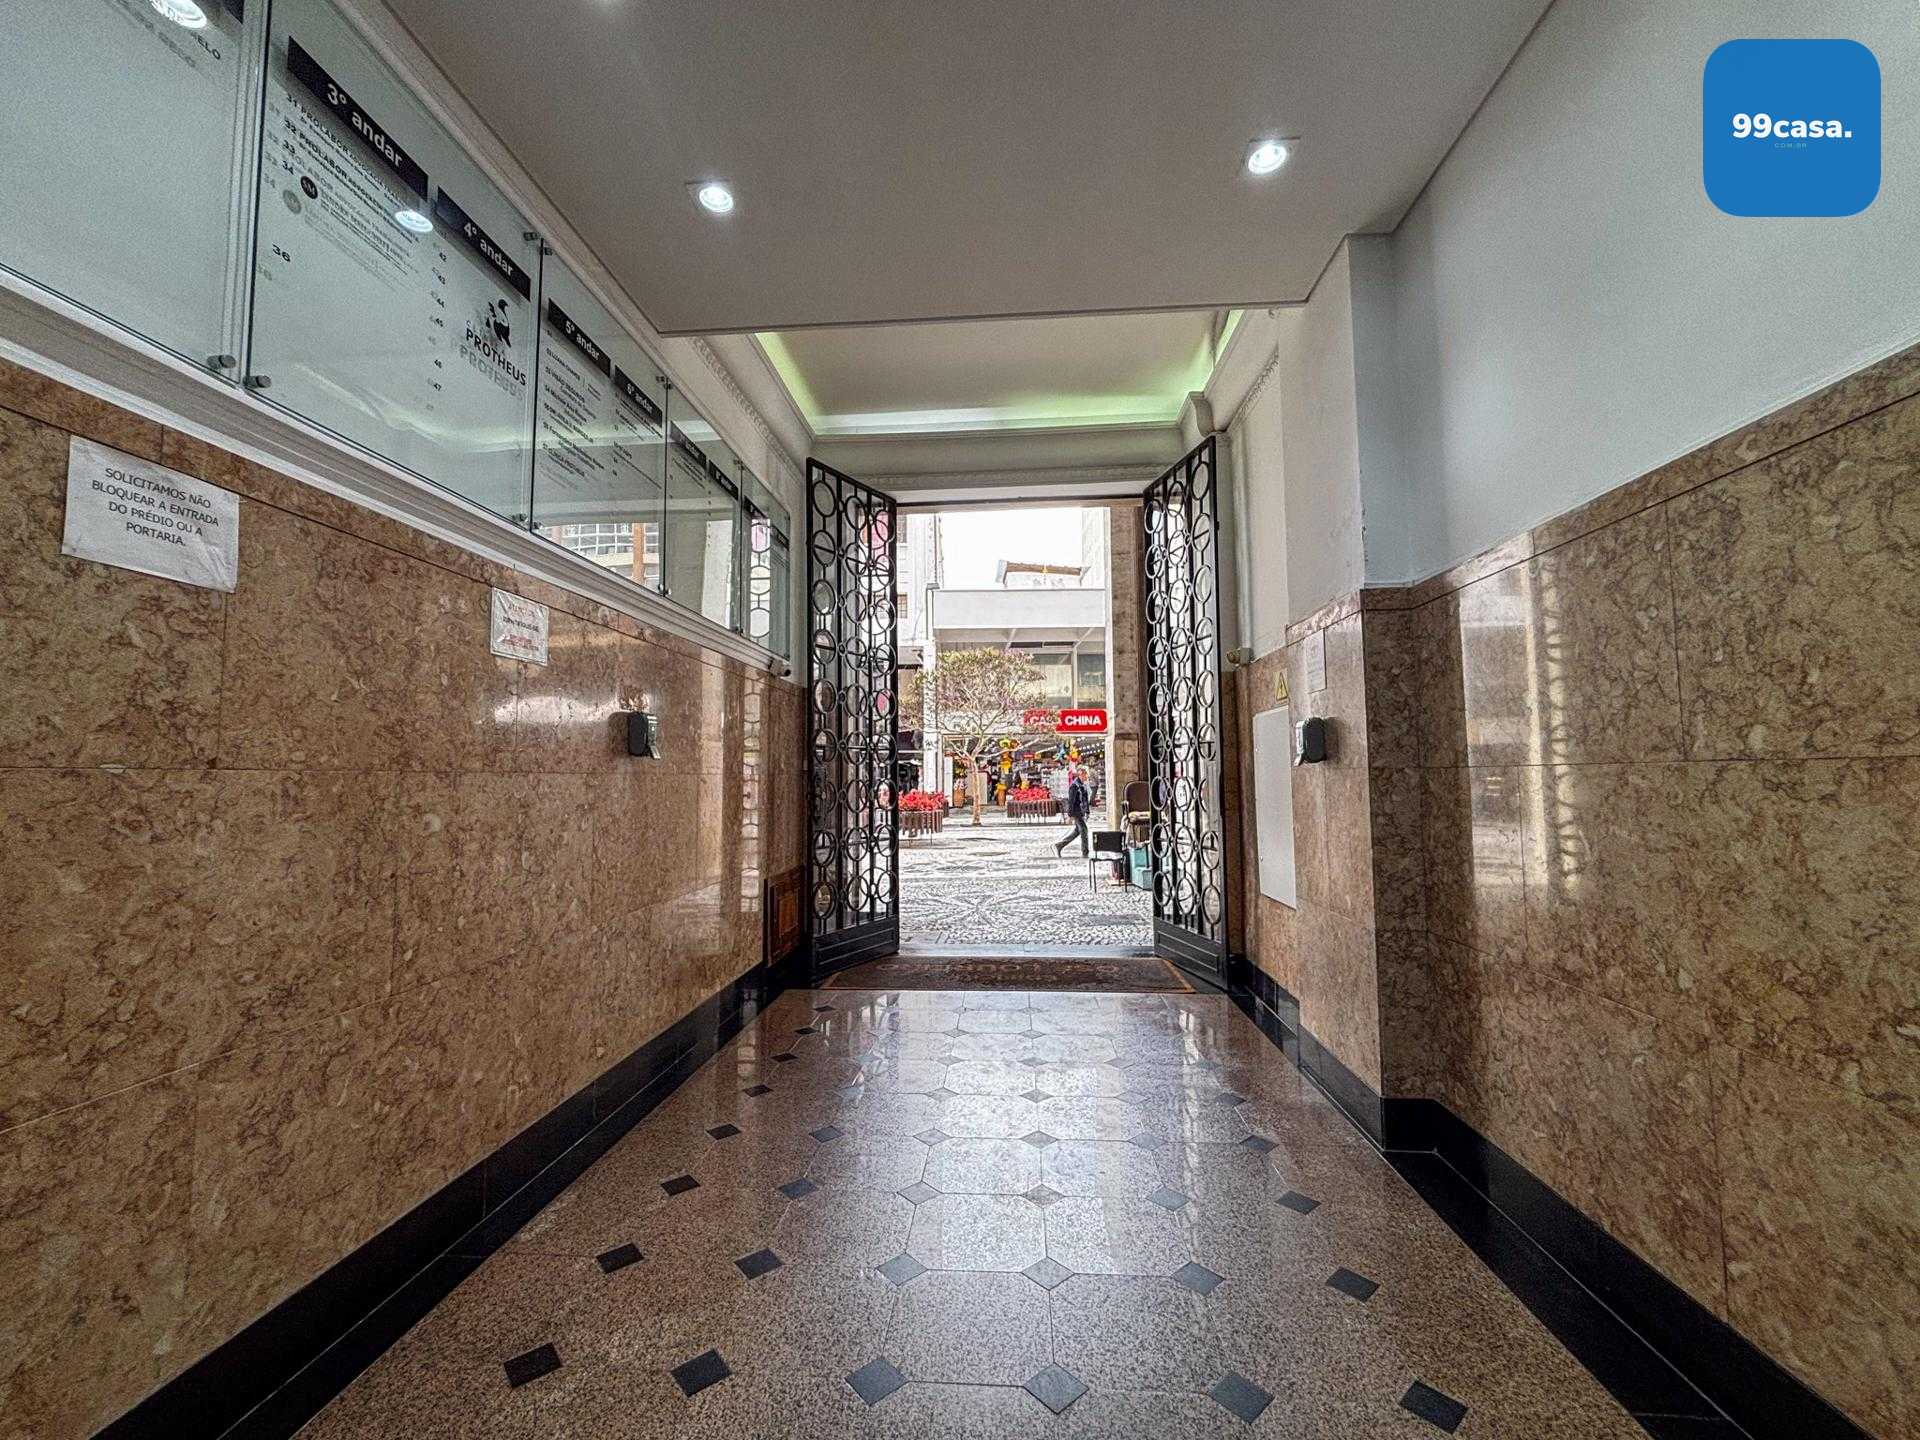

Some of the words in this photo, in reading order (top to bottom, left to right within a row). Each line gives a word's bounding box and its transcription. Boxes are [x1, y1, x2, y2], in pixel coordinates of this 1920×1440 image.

[299, 131, 348, 180] PROLABOR
[351, 111, 404, 168] andar
[272, 243, 291, 263] 36
[479, 239, 514, 277] andar
[466, 328, 526, 386] PROTHEUS
[576, 333, 600, 361] andar
[92, 480, 155, 508] BLOQUEAR
[158, 501, 167, 511] A
[169, 504, 220, 527] ENTRADA
[105, 467, 187, 501] SOLICITAMOS
[189, 494, 211, 508] NÃO
[109, 501, 128, 514] DO
[131, 507, 174, 529] PRÉDIO
[176, 520, 192, 534] OU
[195, 526, 203, 537] A
[126, 521, 187, 547] PORTARIA.
[1064, 715, 1102, 726] CHINA
